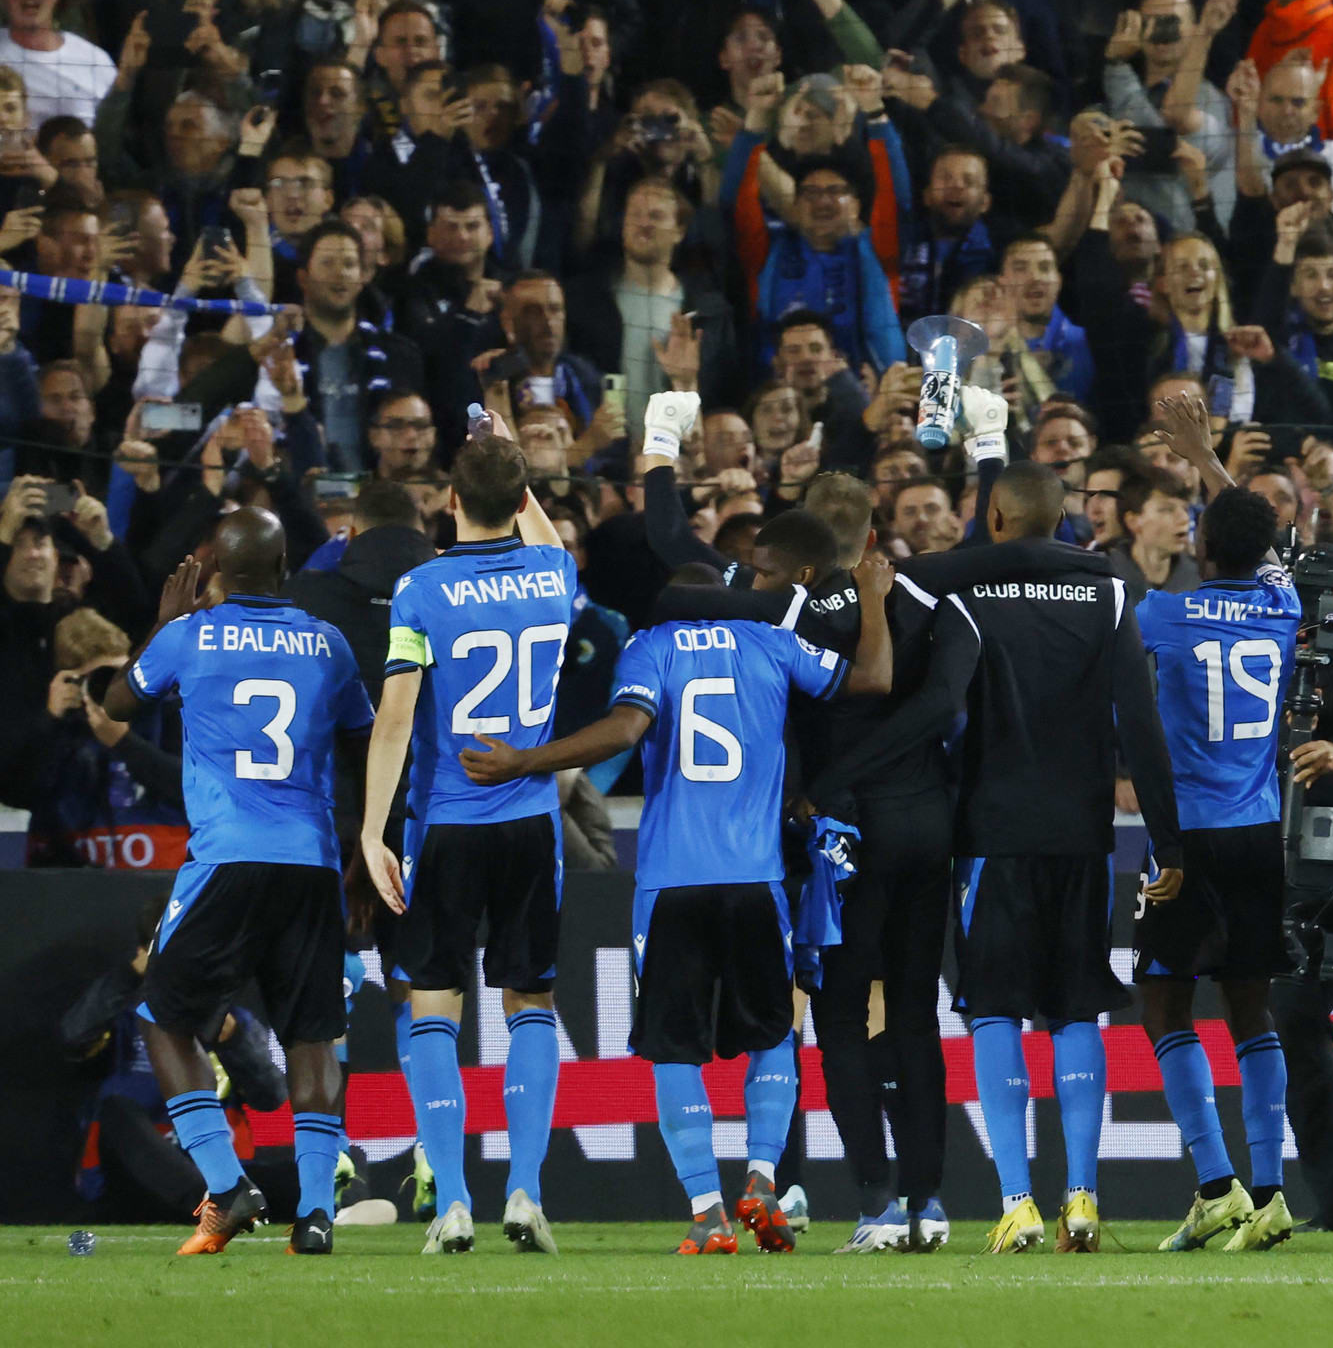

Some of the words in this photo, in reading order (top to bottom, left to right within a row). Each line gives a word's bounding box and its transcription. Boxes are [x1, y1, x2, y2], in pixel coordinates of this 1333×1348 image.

[441, 569, 566, 607] VANAKEN
[973, 582, 1020, 599] CLUB
[1024, 583, 1098, 602] BRUGGE
[198, 624, 219, 651] E.
[224, 627, 332, 658] BALANTA
[450, 623, 570, 735] 20
[1193, 639, 1282, 742] 19
[232, 679, 297, 781] 3
[680, 677, 743, 782] 6
[426, 1099, 457, 1111] 1891
